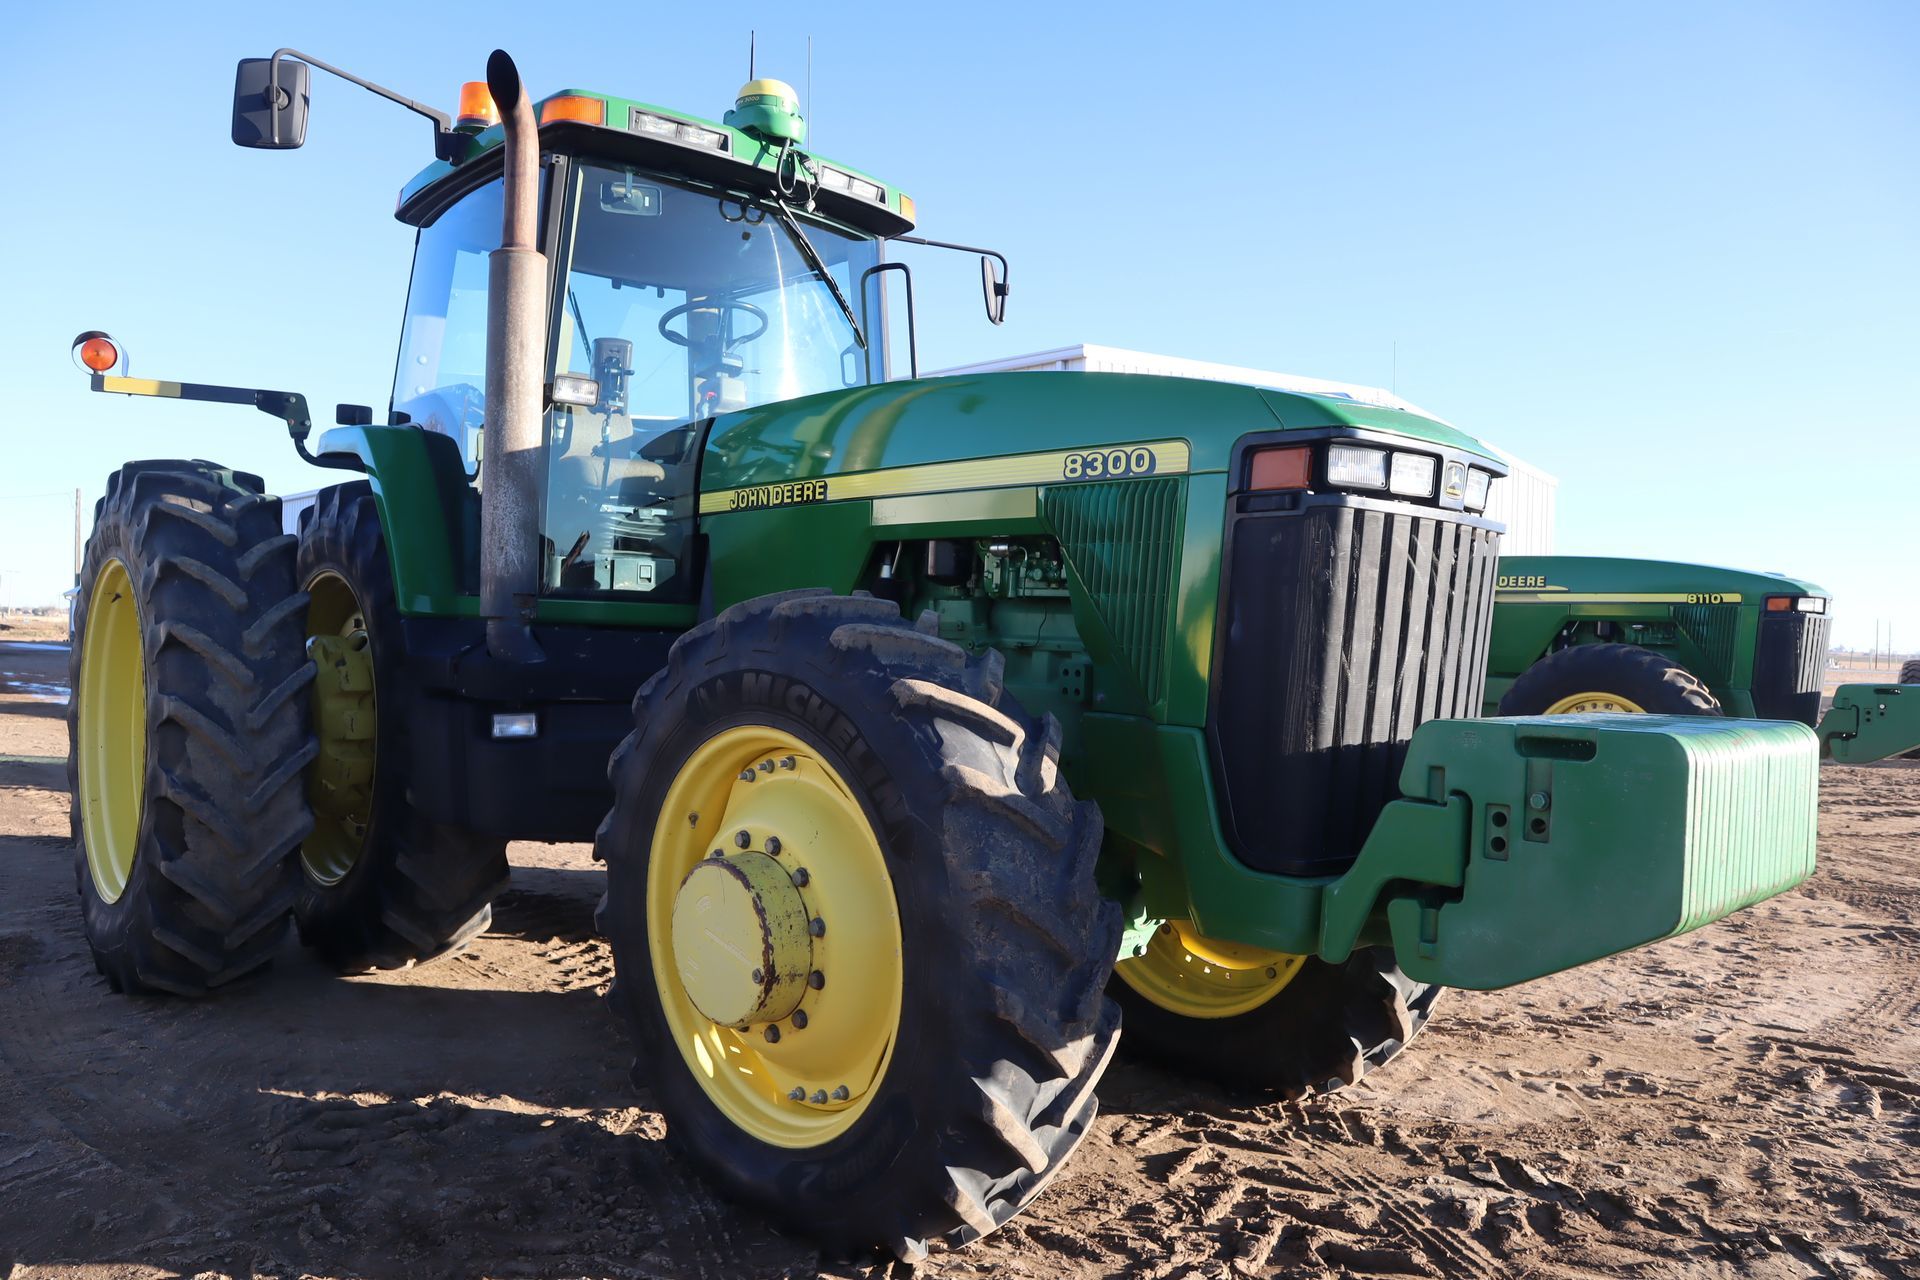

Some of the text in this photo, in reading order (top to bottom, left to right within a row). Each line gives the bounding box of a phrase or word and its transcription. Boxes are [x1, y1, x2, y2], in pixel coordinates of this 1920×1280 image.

[1063, 447, 1156, 480] 8300
[729, 480, 828, 511] JOHN DEERE
[1499, 575, 1546, 588] DEERE
[1687, 593, 1723, 604] 8110
[741, 671, 906, 826] MICHELIN
